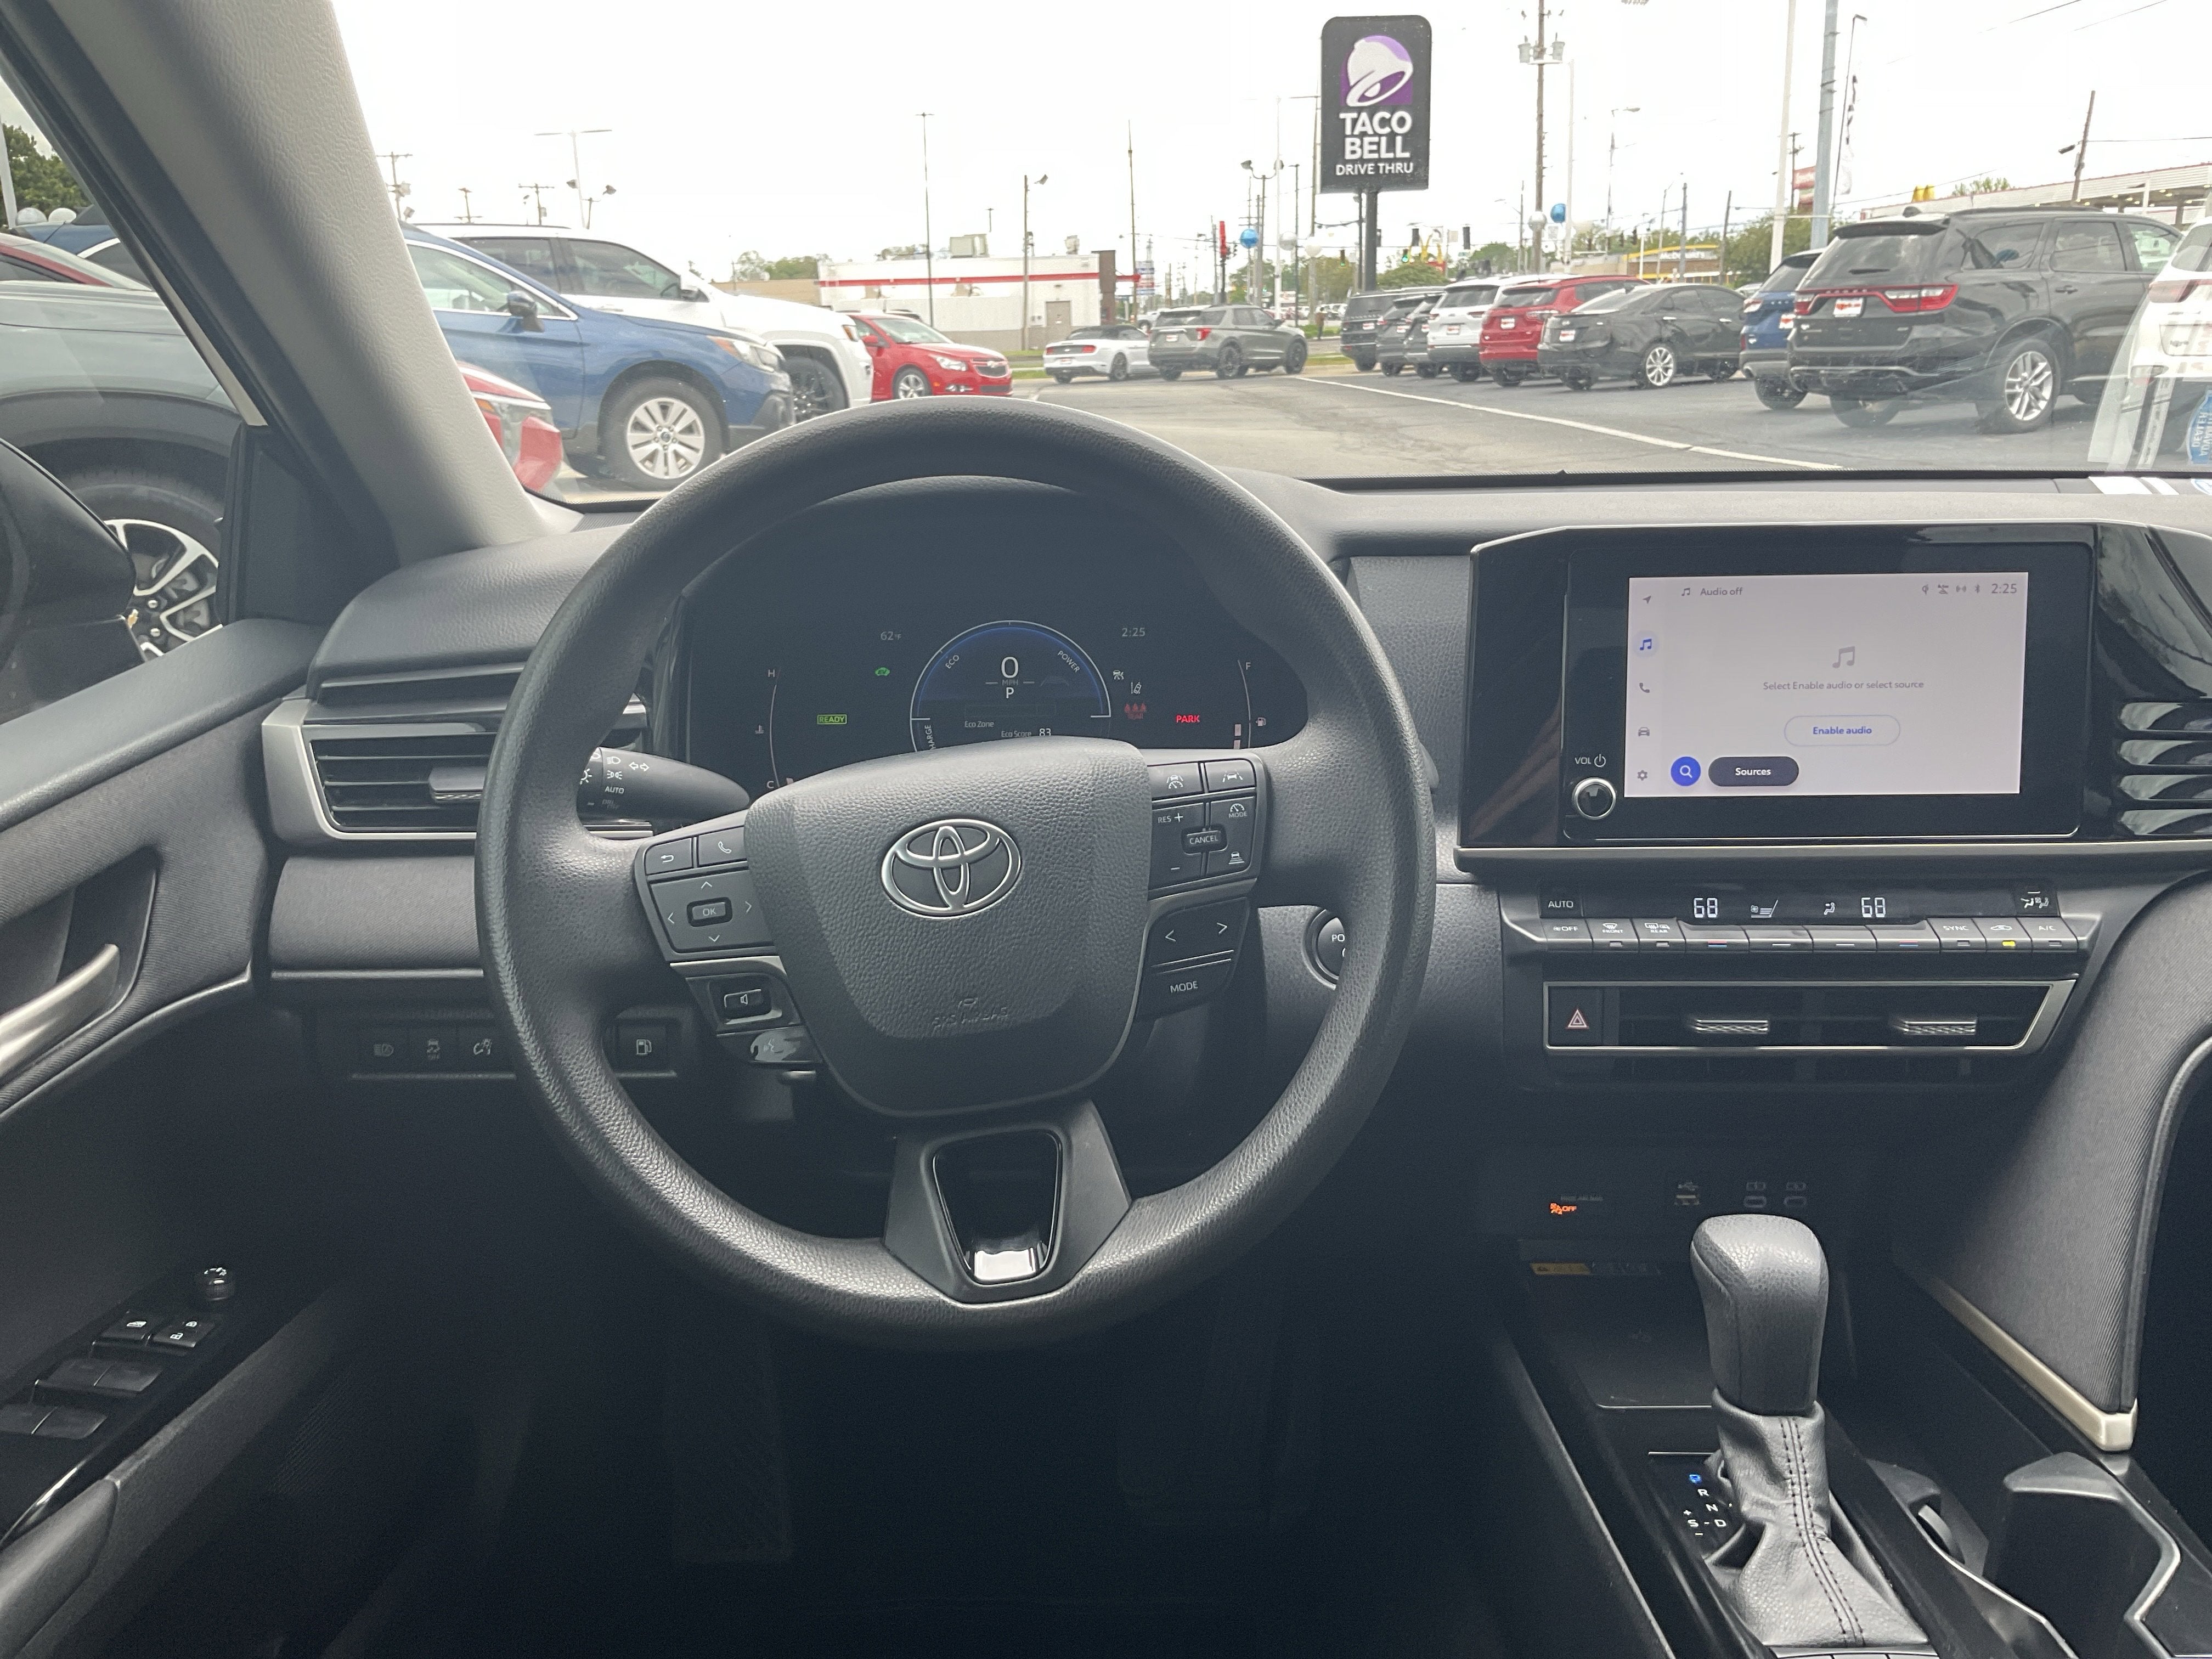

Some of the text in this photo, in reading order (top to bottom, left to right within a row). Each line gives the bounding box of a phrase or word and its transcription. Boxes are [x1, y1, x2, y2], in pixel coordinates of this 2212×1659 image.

[1339, 111, 1413, 136] TACO
[1344, 136, 1411, 160] BELL
[1335, 162, 1414, 176] DRIVE THRU
[1700, 587, 1743, 596] Audio off
[1991, 583, 2017, 594] 2:25
[1121, 627, 1146, 637] 2:25
[945, 654, 960, 669] ECO
[1057, 650, 1080, 673] POWER
[1245, 662, 1251, 670] F
[1000, 656, 1019, 679] 0
[768, 669, 775, 678] H
[1763, 681, 1791, 690] Select
[1792, 681, 1825, 690] Enable
[1006, 687, 1014, 699] P
[1176, 714, 1200, 723] PARK
[1039, 728, 1051, 736] 83
[1813, 726, 1872, 735] Enable audio
[924, 725, 936, 750] HARGE
[1575, 757, 1592, 765] VOL
[1735, 767, 1771, 776] Sources
[767, 780, 774, 789] C
[605, 786, 625, 794] AUTO
[1189, 835, 1219, 845] CANCEL
[703, 907, 716, 916] OK
[1694, 897, 1718, 918] 68
[1861, 897, 1886, 918] 68
[1170, 980, 1199, 994] MODE
[1688, 1519, 1699, 1527] S
[1714, 1519, 1726, 1527] D
